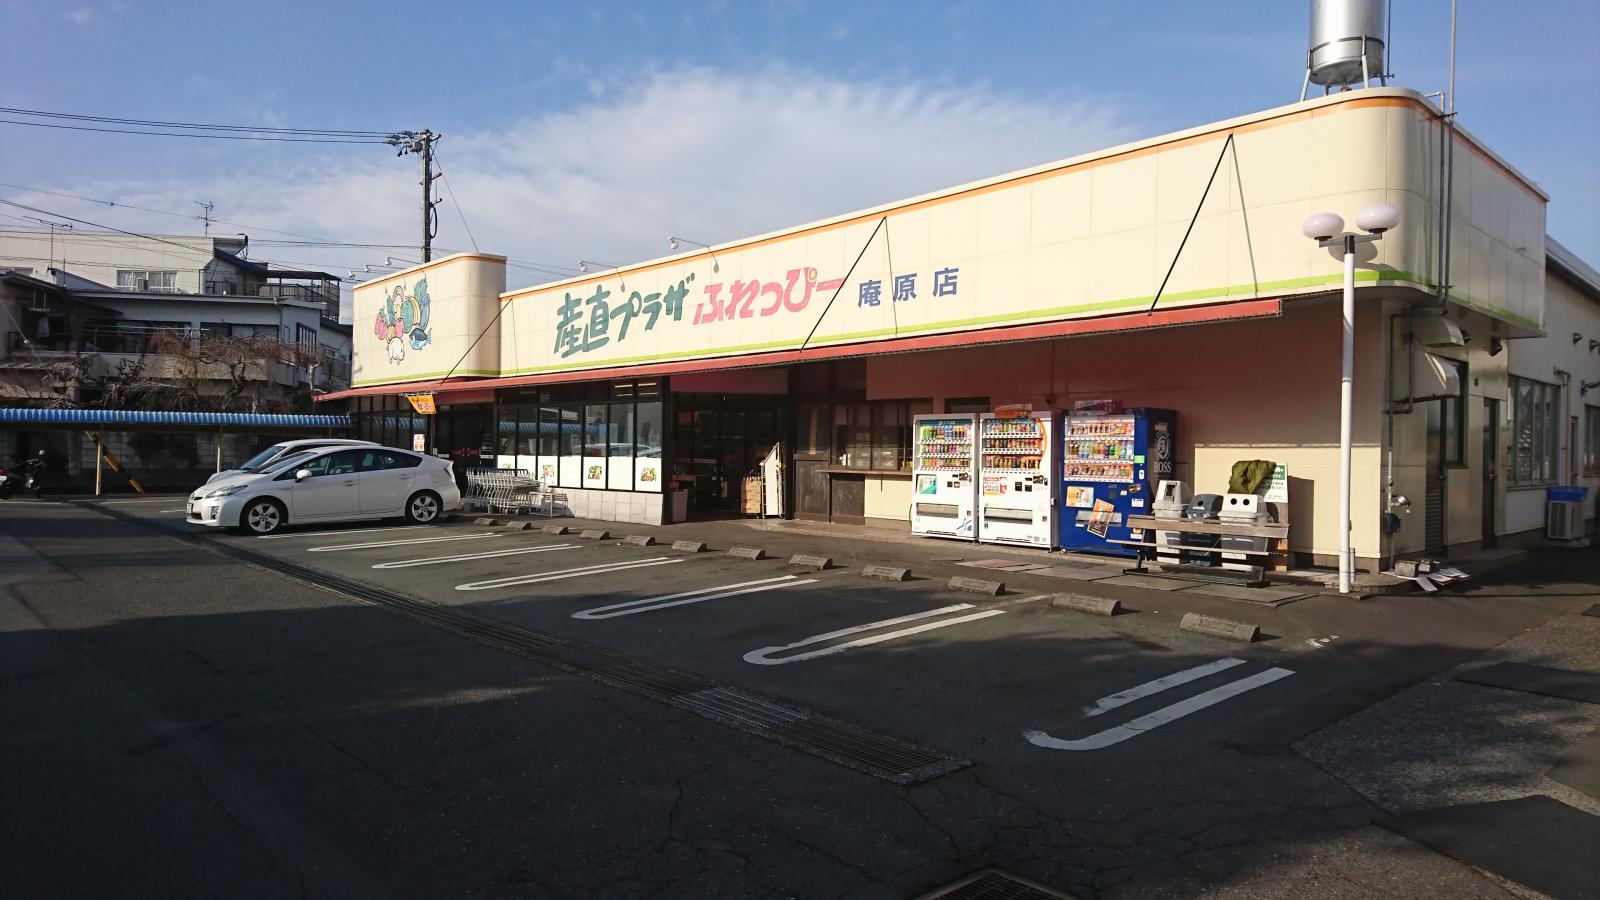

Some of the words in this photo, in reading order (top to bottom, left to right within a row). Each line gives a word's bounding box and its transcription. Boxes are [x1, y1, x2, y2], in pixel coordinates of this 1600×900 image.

[554, 272, 695, 358] 産直プラザ
[857, 267, 959, 308] 庵原店
[1153, 461, 1171, 473] BOSS
